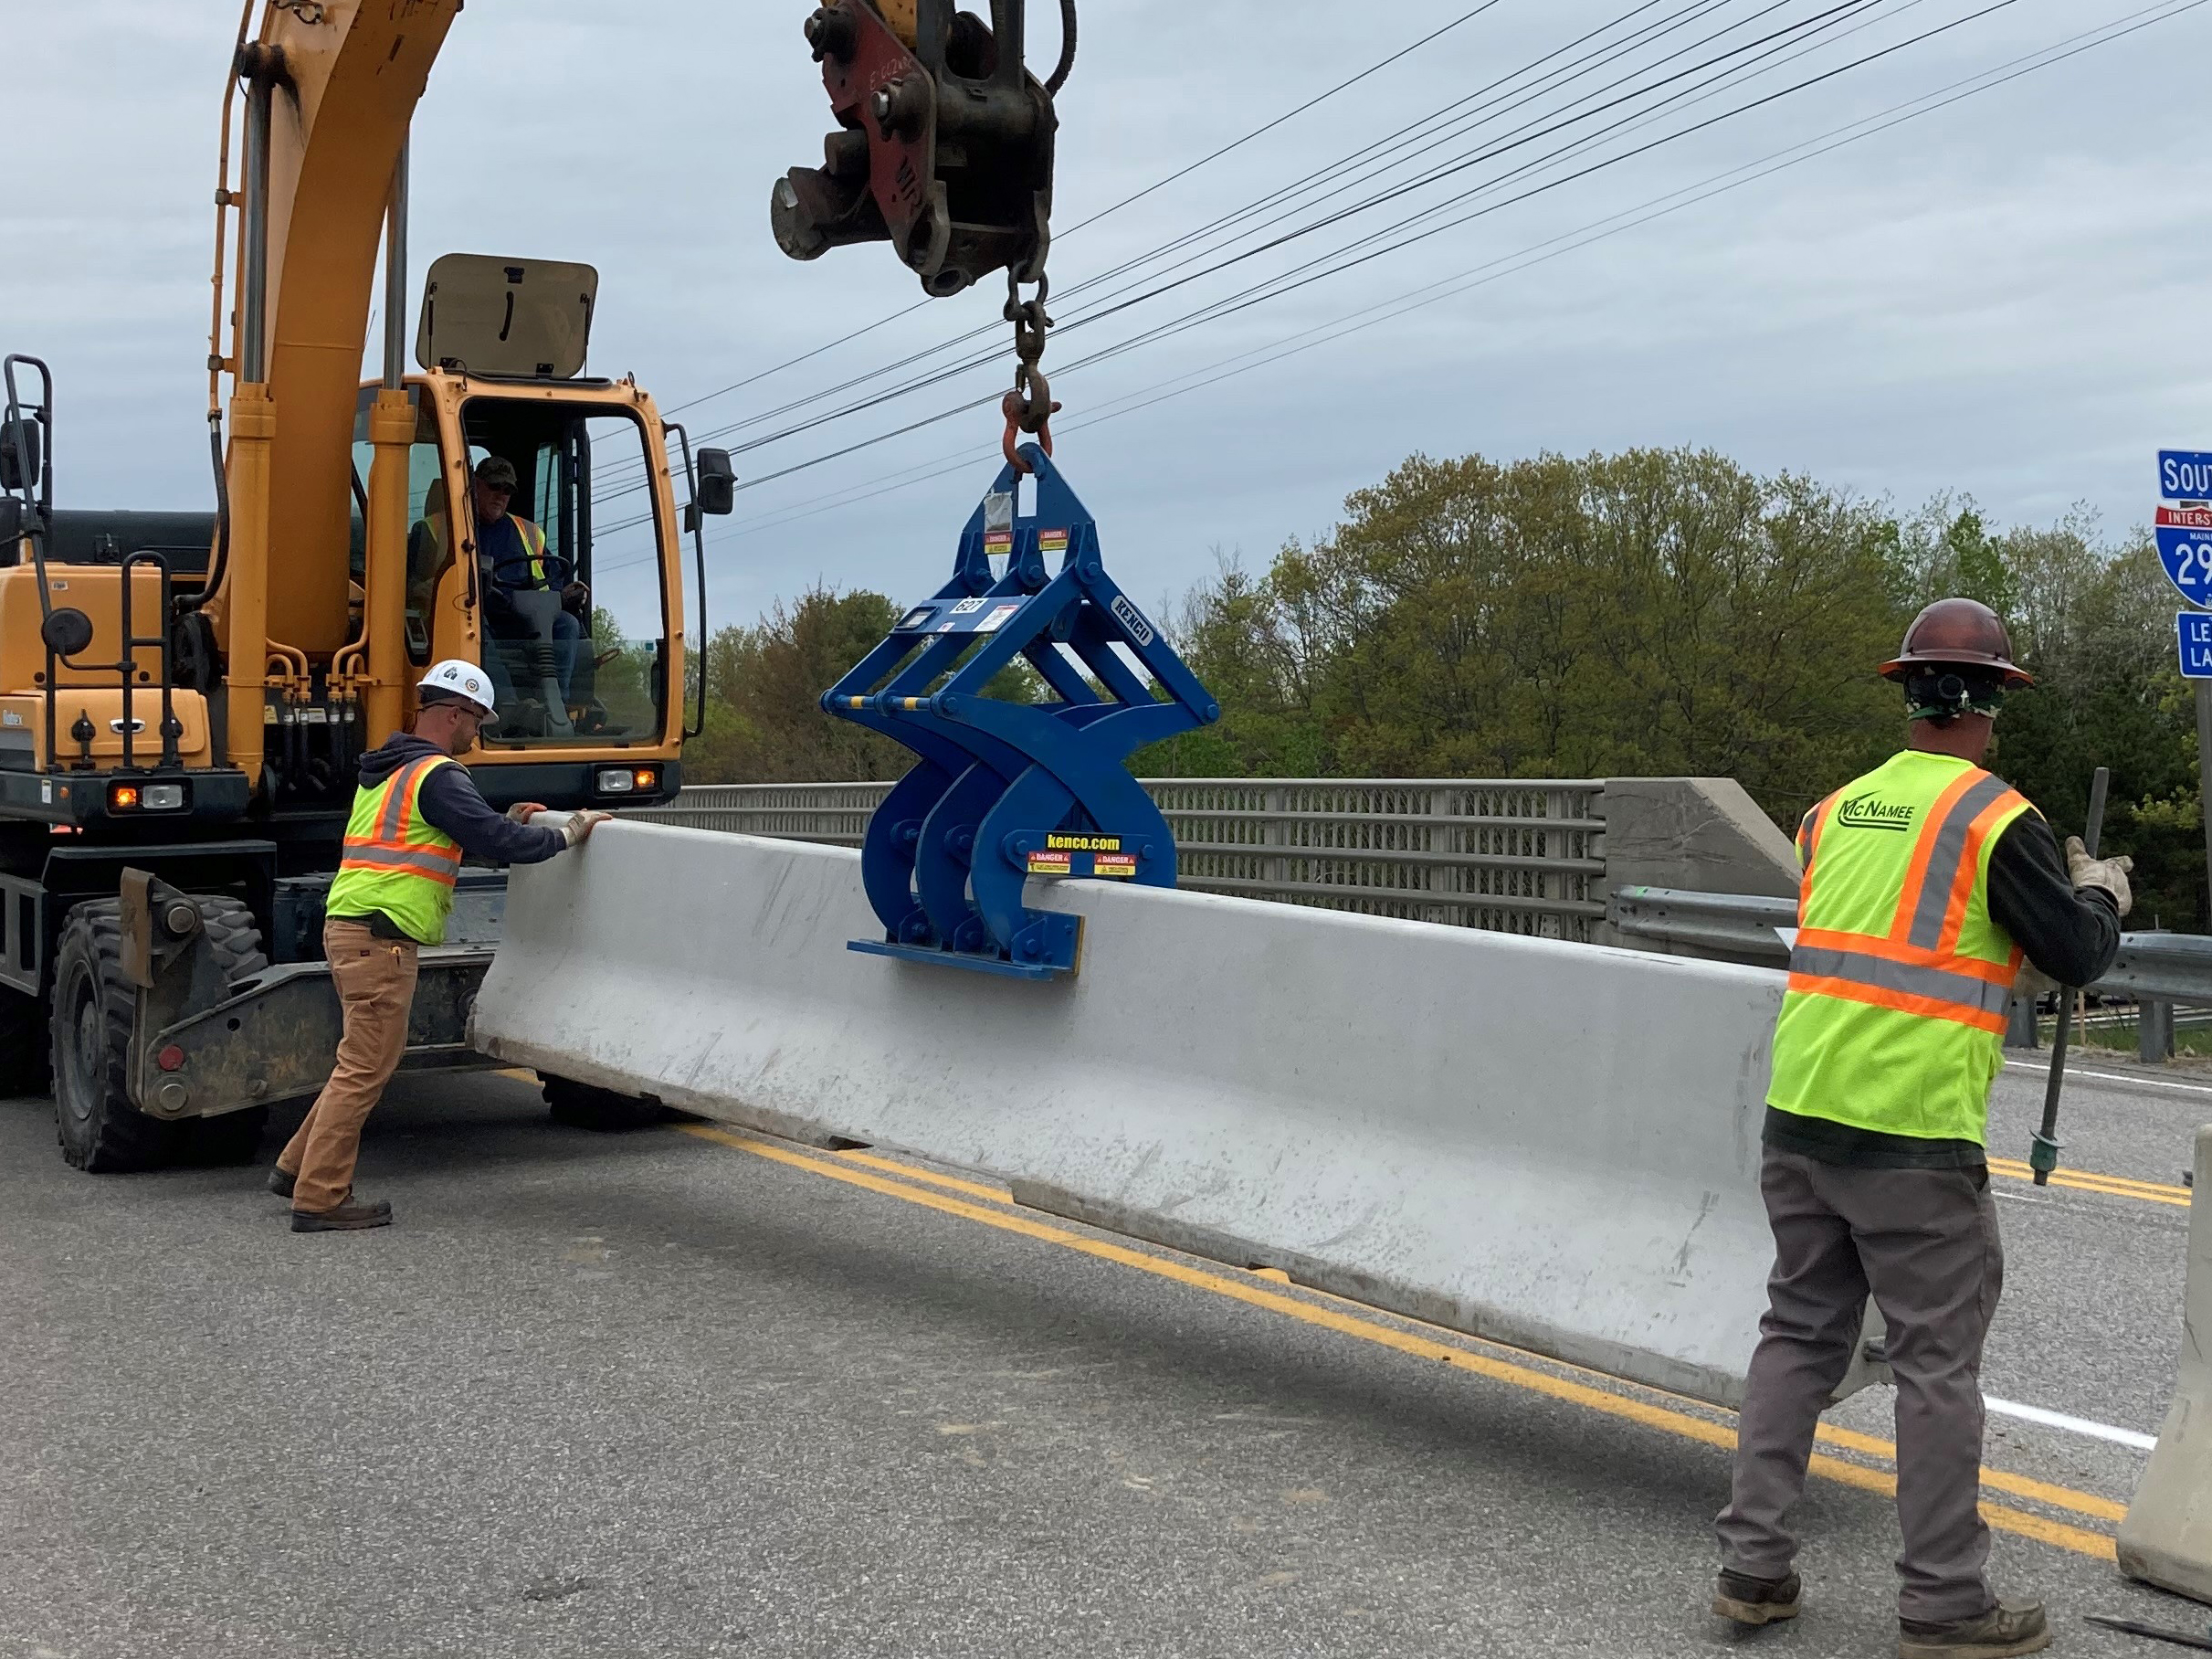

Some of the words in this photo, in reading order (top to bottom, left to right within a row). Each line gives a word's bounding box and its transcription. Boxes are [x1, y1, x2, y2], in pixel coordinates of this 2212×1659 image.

[2168, 511, 2212, 525] INTERS
[2189, 532, 2212, 540] MAIN
[2175, 543, 2212, 585] 29
[955, 600, 984, 612] 627
[1114, 599, 1150, 641] KENCO
[2190, 622, 2211, 642] LE
[2190, 647, 2212, 667] LA
[1047, 834, 1120, 851] kenco.com
[1036, 851, 1063, 862] DANGER
[1101, 854, 1129, 864] DANGER
